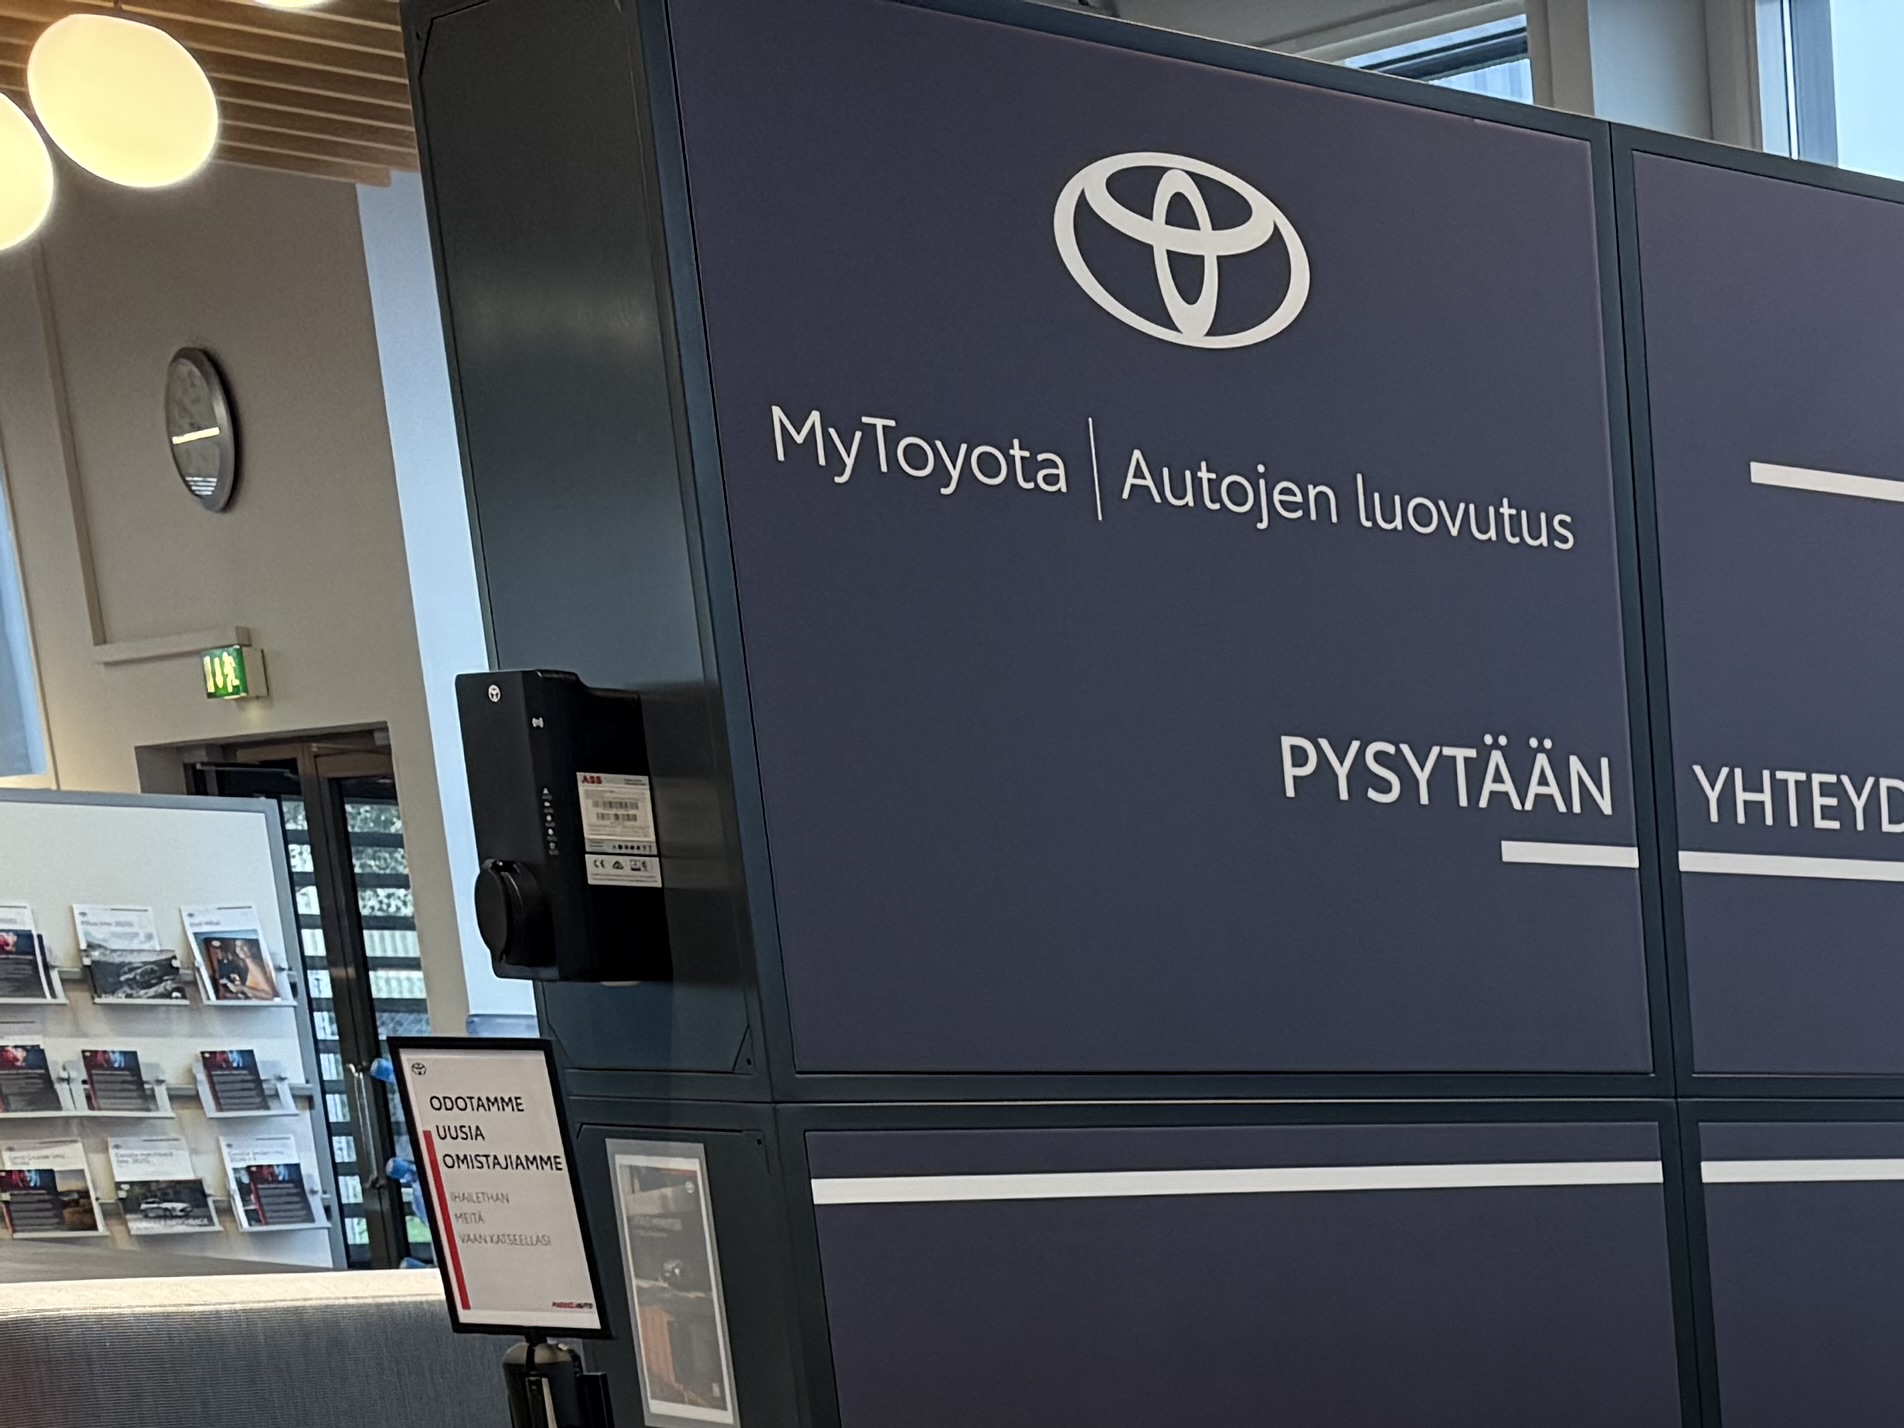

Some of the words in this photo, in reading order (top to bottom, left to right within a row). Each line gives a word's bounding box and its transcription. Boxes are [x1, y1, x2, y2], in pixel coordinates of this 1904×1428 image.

[771, 405, 1067, 495] MyToyota
[1121, 449, 1338, 530] Autojen
[1356, 473, 1575, 550] luovutus
[581, 775, 603, 785] ABB
[1280, 733, 1613, 816] PYSYTÄÄN
[429, 1095, 525, 1113] ODOTAMME
[435, 1124, 486, 1141] UUSIA
[443, 1154, 564, 1171] OMISTAJIAMME
[459, 1233, 488, 1245] VAAN
